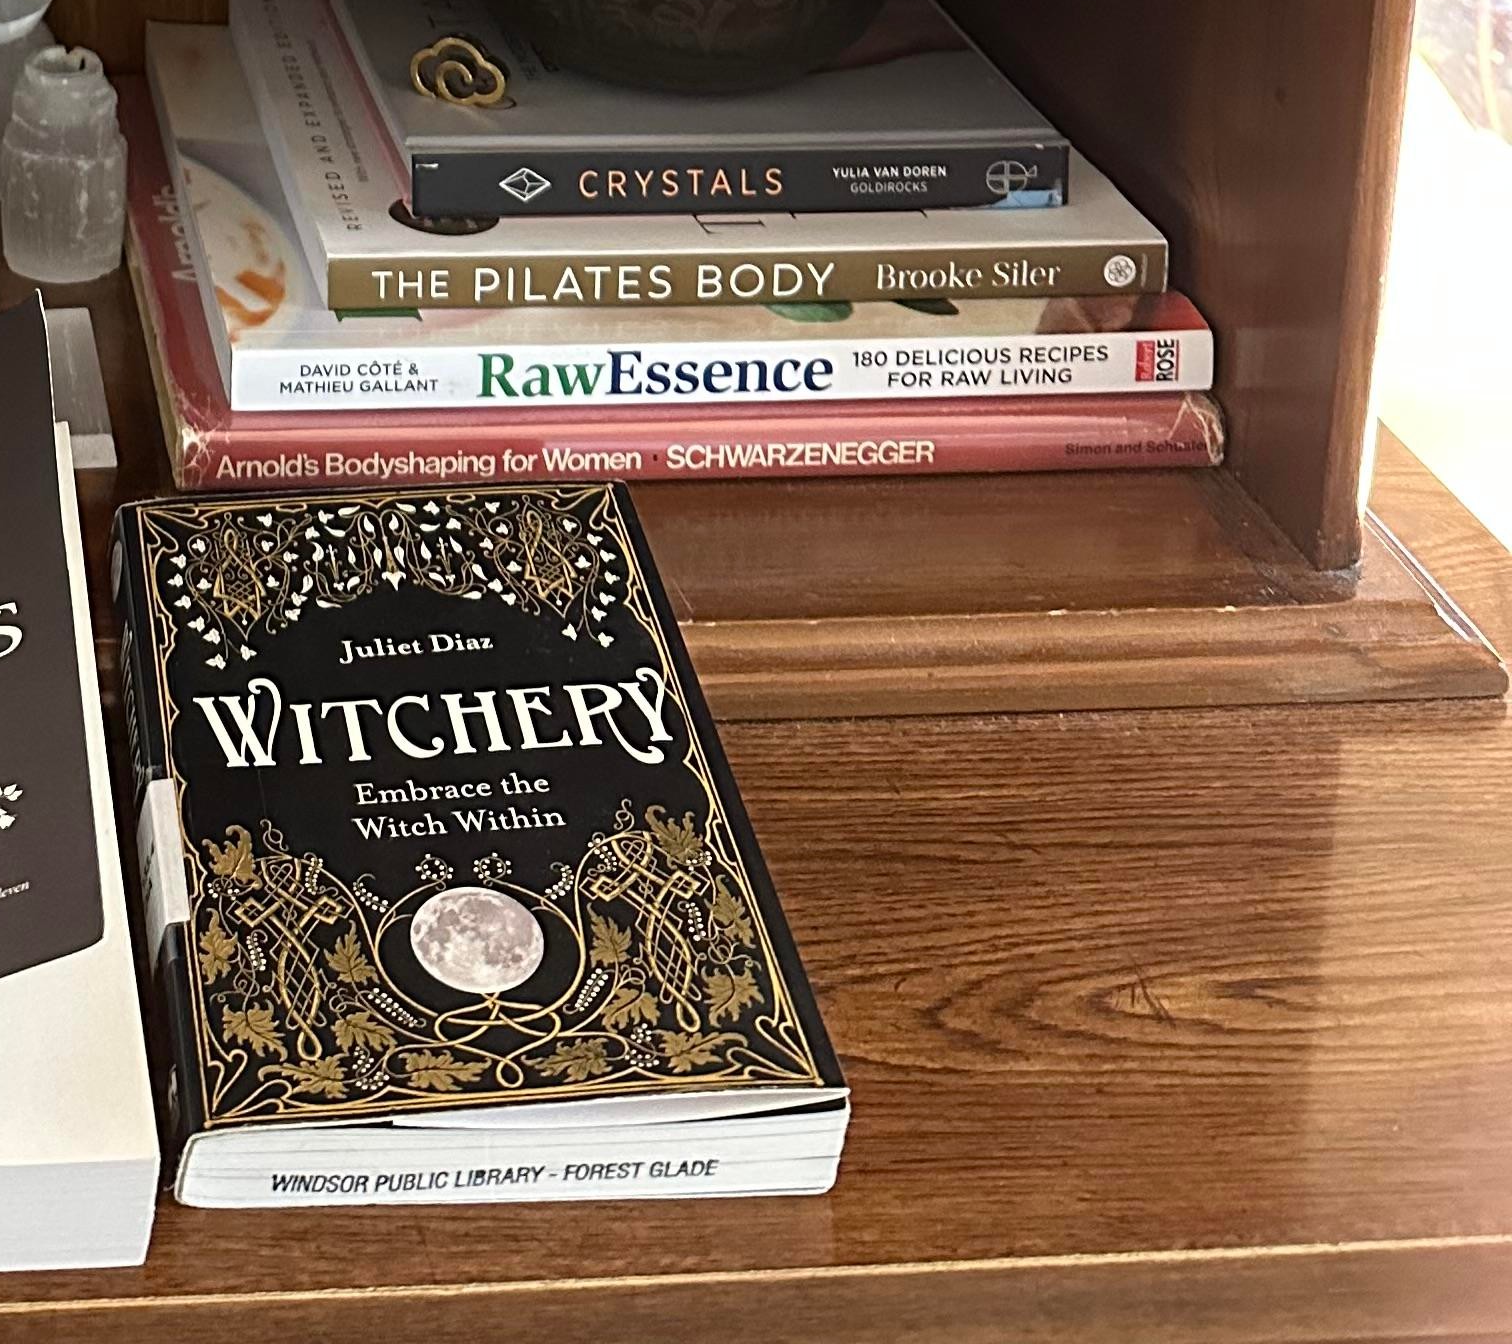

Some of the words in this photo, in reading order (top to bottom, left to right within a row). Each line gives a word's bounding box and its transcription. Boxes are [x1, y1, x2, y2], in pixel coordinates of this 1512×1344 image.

[578, 168, 784, 199] CRYSTALS
[832, 166, 868, 179] YULIA
[874, 166, 901, 178] VAN
[905, 165, 947, 178] DOREN
[851, 181, 928, 194] GOLDIROCKS
[372, 270, 451, 300] THE
[474, 265, 673, 302] PILATES
[696, 263, 836, 297] BODY
[876, 261, 982, 289] Brooke
[992, 260, 1061, 285] Siler
[300, 363, 351, 377] DAVID
[356, 359, 402, 377] CÔTÉ
[408, 362, 419, 375] &
[852, 350, 887, 368] 180
[895, 347, 1011, 367] DELICIOUS
[1018, 345, 1109, 364] RECIPES
[279, 381, 354, 395] MATHIEU
[359, 378, 438, 393] GALLANT
[476, 349, 834, 399] RawEssence
[887, 370, 933, 388] FOR
[940, 370, 992, 386] RAW
[1001, 368, 1072, 385] LIVING
[216, 453, 319, 478] Arnold's
[325, 449, 496, 478] Bodyshaping
[502, 449, 538, 472] for
[543, 450, 641, 471] Women
[666, 441, 935, 470] SCHWARZENEGGER
[340, 638, 424, 664] Juliet
[428, 634, 494, 656] Diaz
[192, 667, 674, 768] WITCHERY
[354, 780, 493, 806] Embrace
[500, 774, 550, 796] the
[352, 814, 448, 841] Witch
[454, 808, 566, 833] Within
[271, 1174, 369, 1194] WINDSOR
[375, 1173, 450, 1191] PUBLIC
[454, 1166, 546, 1187] LIBRARY
[563, 1162, 641, 1183] FOREST
[648, 1161, 719, 1178] GLADE
